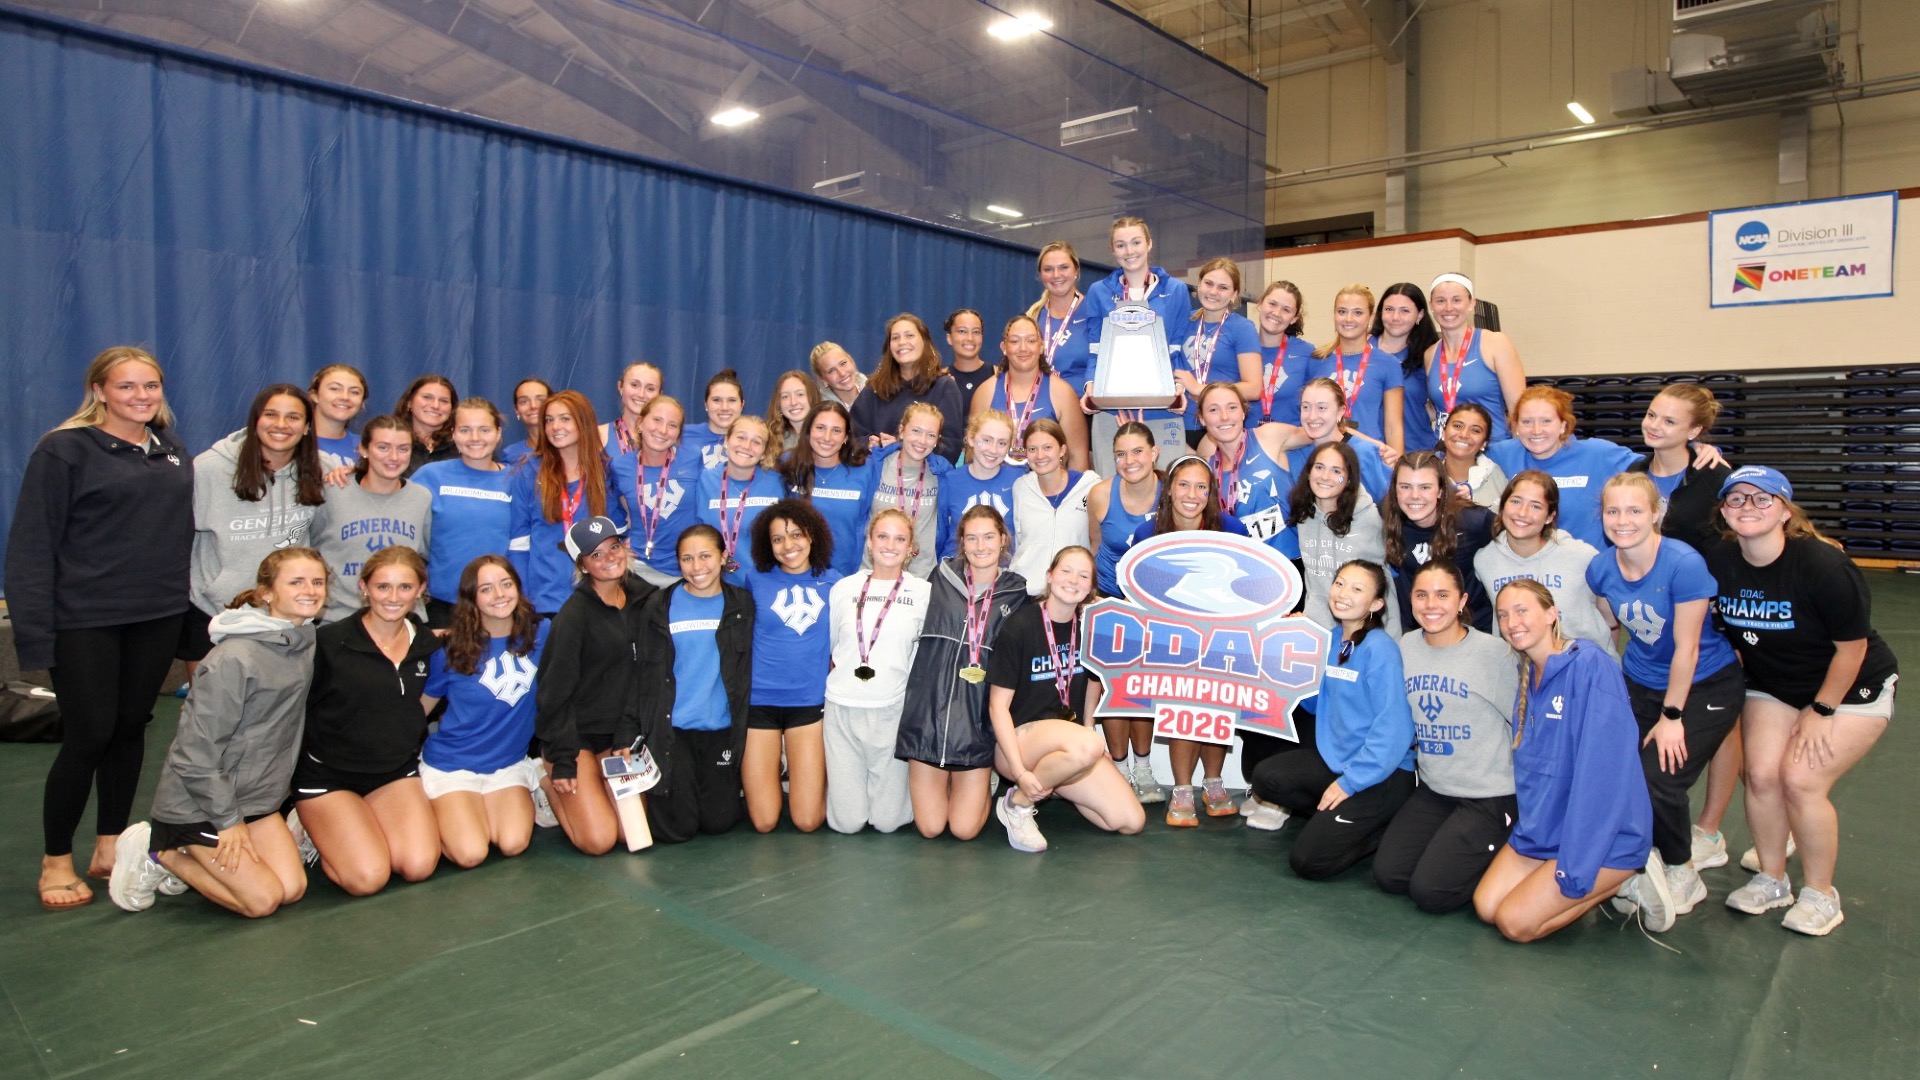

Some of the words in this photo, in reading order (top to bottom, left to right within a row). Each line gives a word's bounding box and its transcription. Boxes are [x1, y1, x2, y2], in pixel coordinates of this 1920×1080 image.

[1738, 233, 1770, 245] NCAA
[1777, 227, 1837, 243] Division
[1842, 224, 1853, 236] III
[1768, 263, 1866, 282] ONETEAM
[341, 517, 416, 541] GENERALS
[1249, 516, 1277, 538] 17
[230, 533, 257, 542] TRACK
[1740, 588, 1765, 599] ODAC
[1719, 596, 1792, 619] CHAMPS
[1089, 609, 1318, 689] ODAC
[1126, 675, 1269, 711] CHAMPIONS
[1157, 708, 1232, 740] 2026
[1415, 722, 1471, 740] HLETICS
